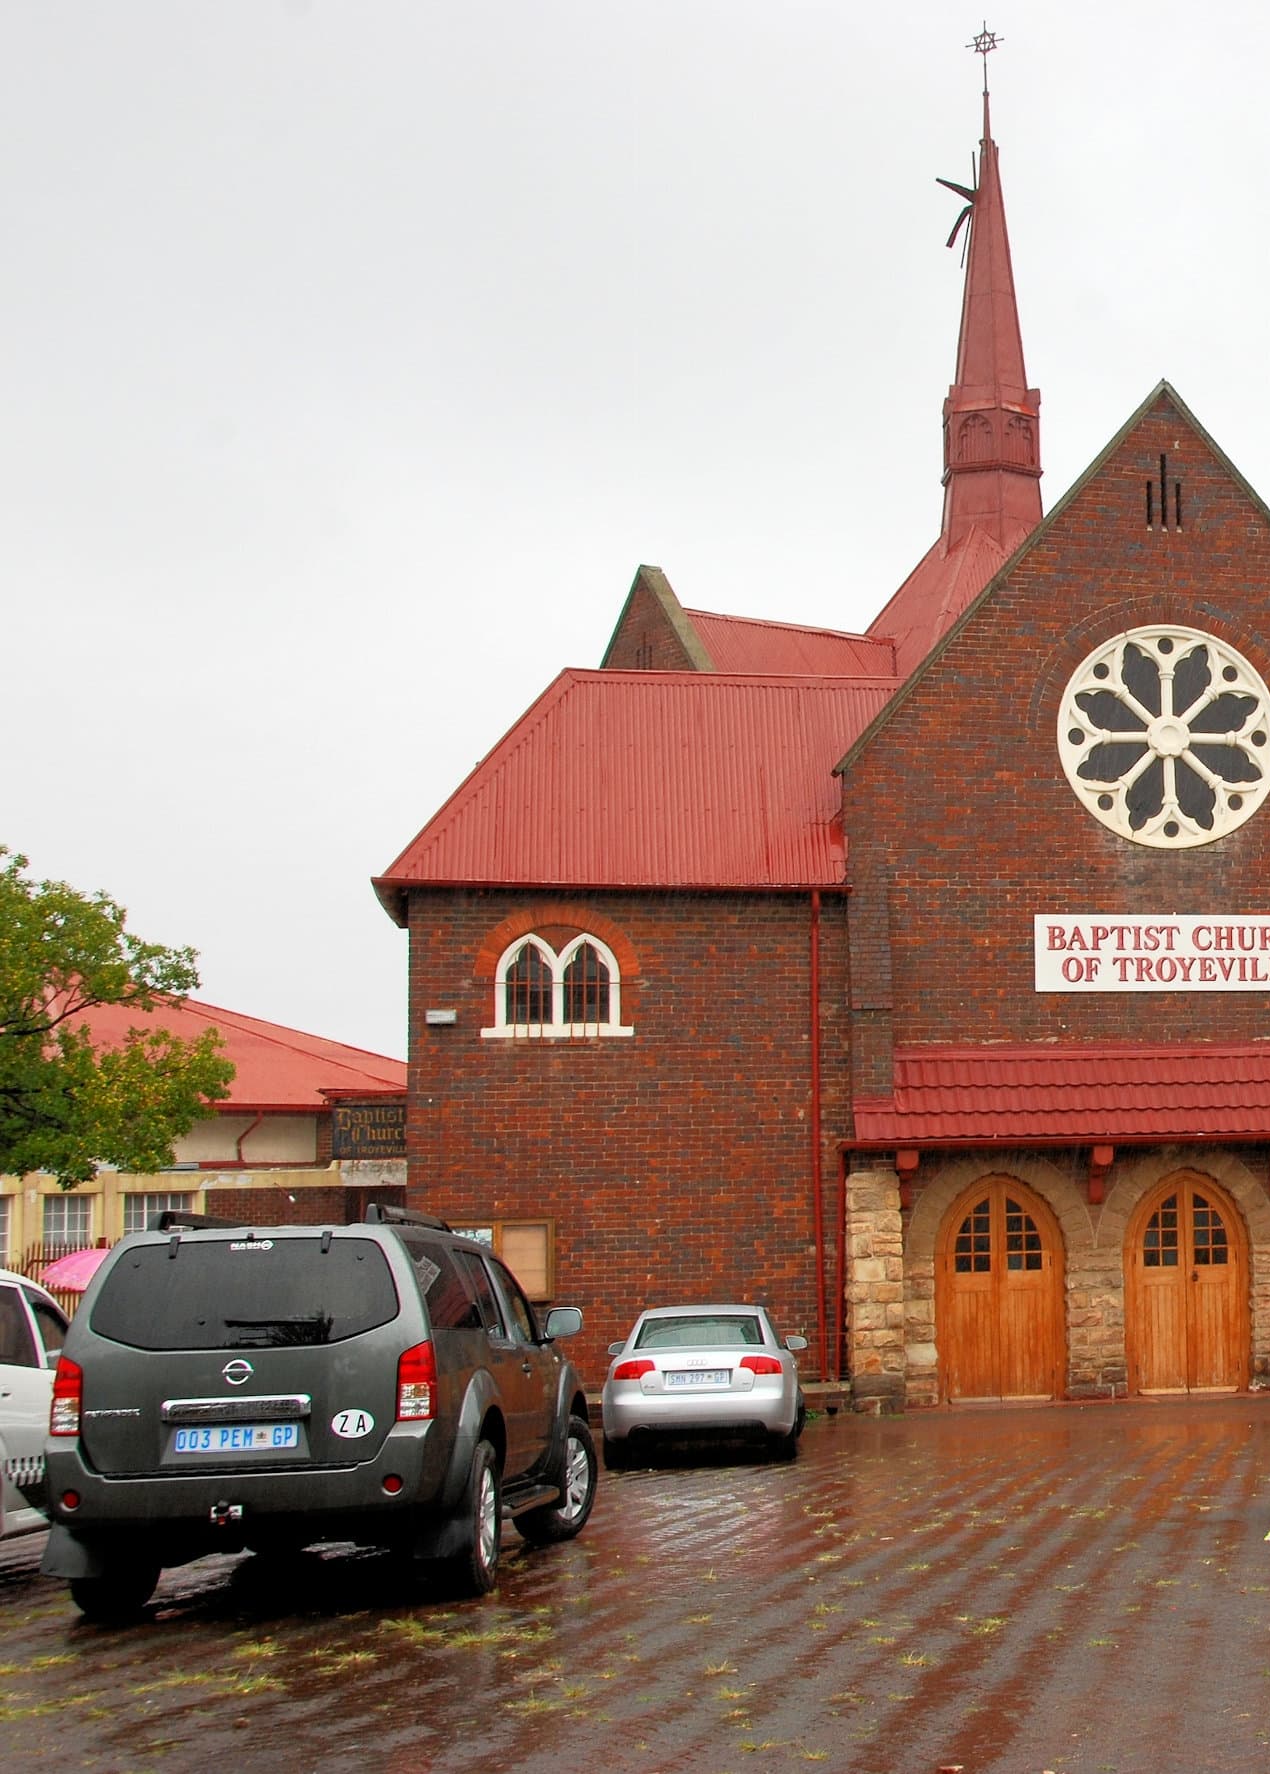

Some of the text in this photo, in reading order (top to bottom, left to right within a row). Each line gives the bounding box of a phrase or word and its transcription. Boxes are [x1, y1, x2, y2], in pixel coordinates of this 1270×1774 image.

[1046, 925, 1181, 951] BAPTIST
[1061, 957, 1101, 982] OF
[336, 1107, 404, 1130] Baptist
[176, 1426, 293, 1451] 003 PEM GP
